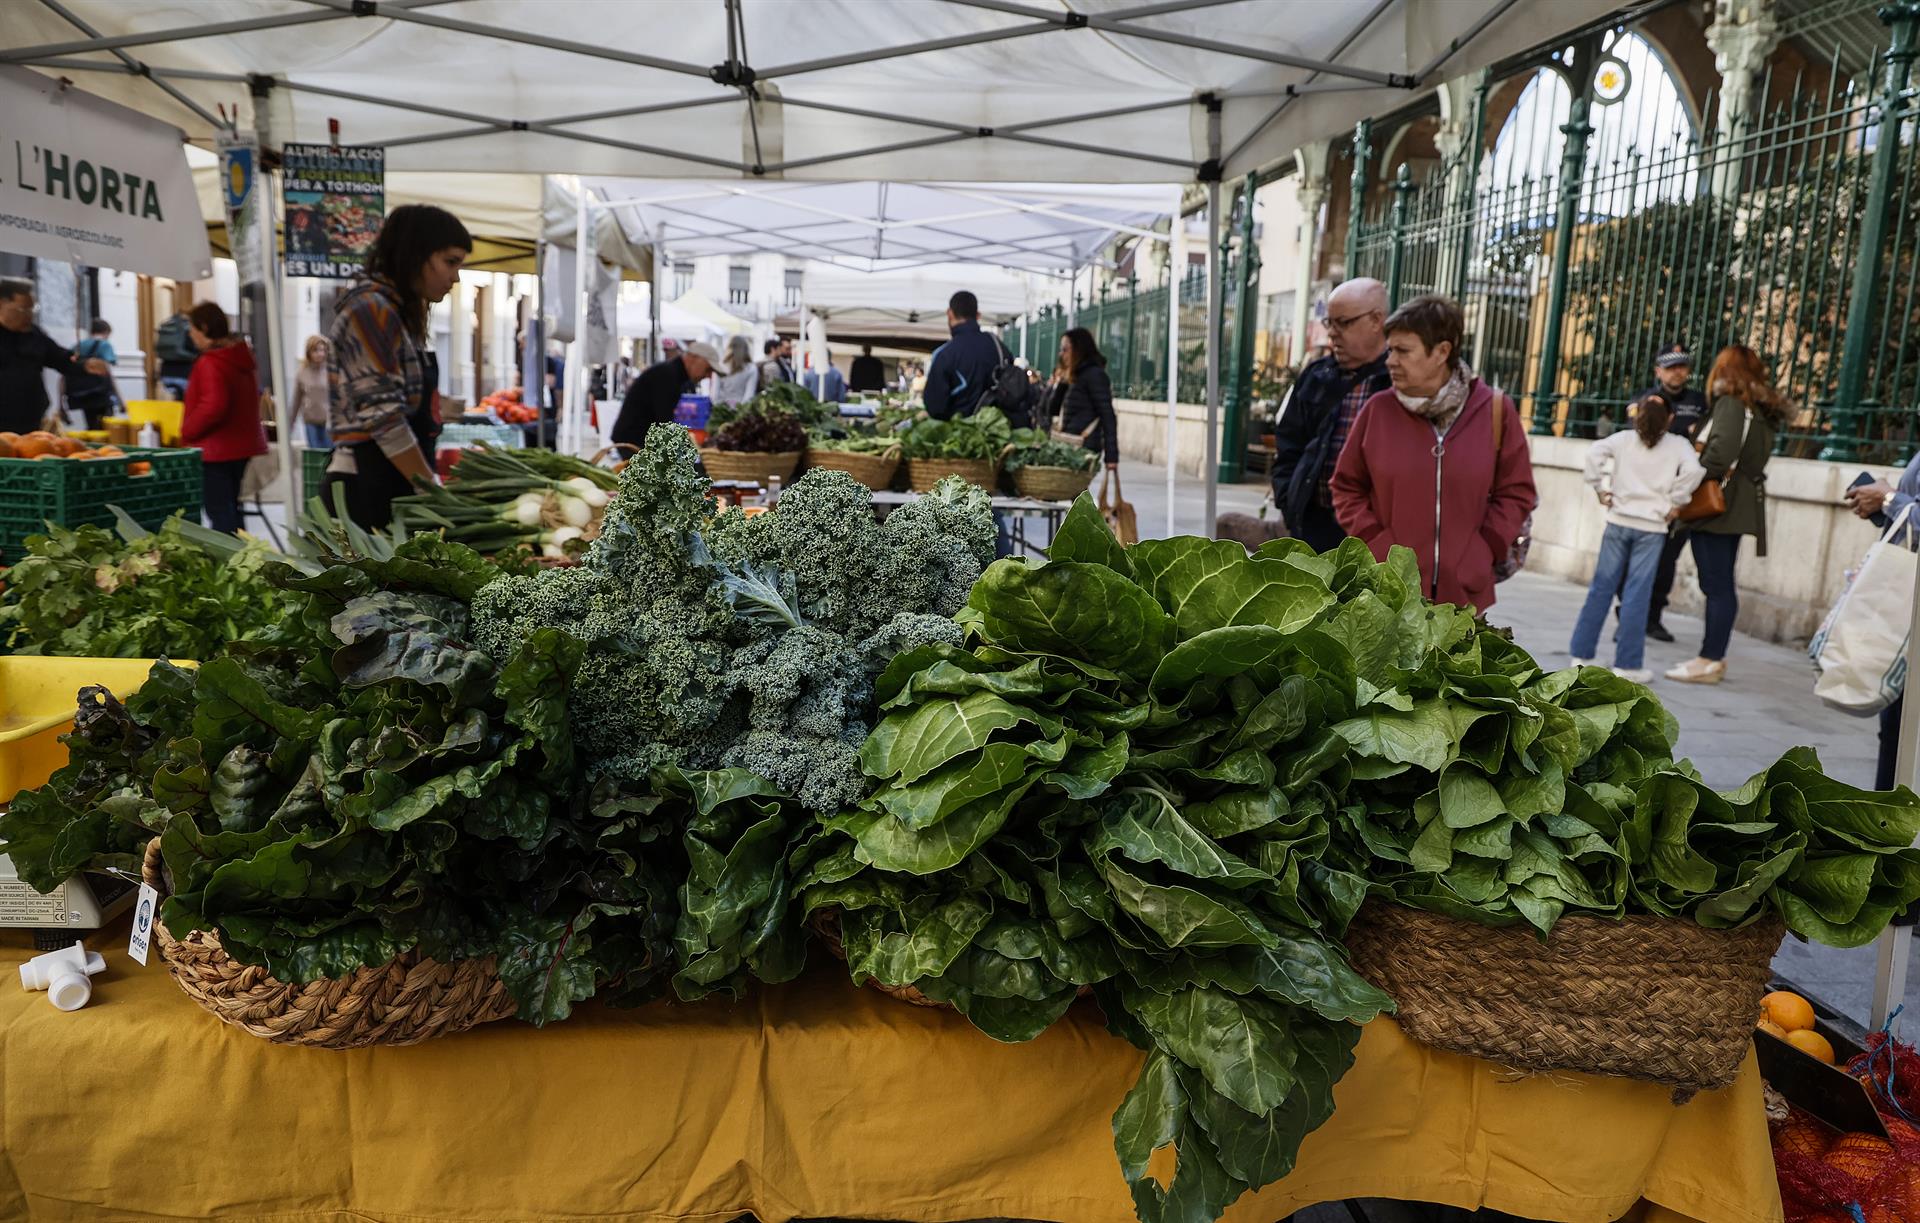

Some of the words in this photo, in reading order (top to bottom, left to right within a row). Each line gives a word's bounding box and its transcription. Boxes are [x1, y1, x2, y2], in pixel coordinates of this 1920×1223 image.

[286, 156, 382, 172] SALUDABLE
[15, 140, 164, 222] L'HORTA
[298, 170, 382, 183] SOSTENIBLE
[284, 179, 311, 190] PER
[313, 180, 324, 191] A
[326, 180, 383, 193] TOTHOM
[327, 255, 366, 264] MENJA
[310, 262, 336, 276] UN
